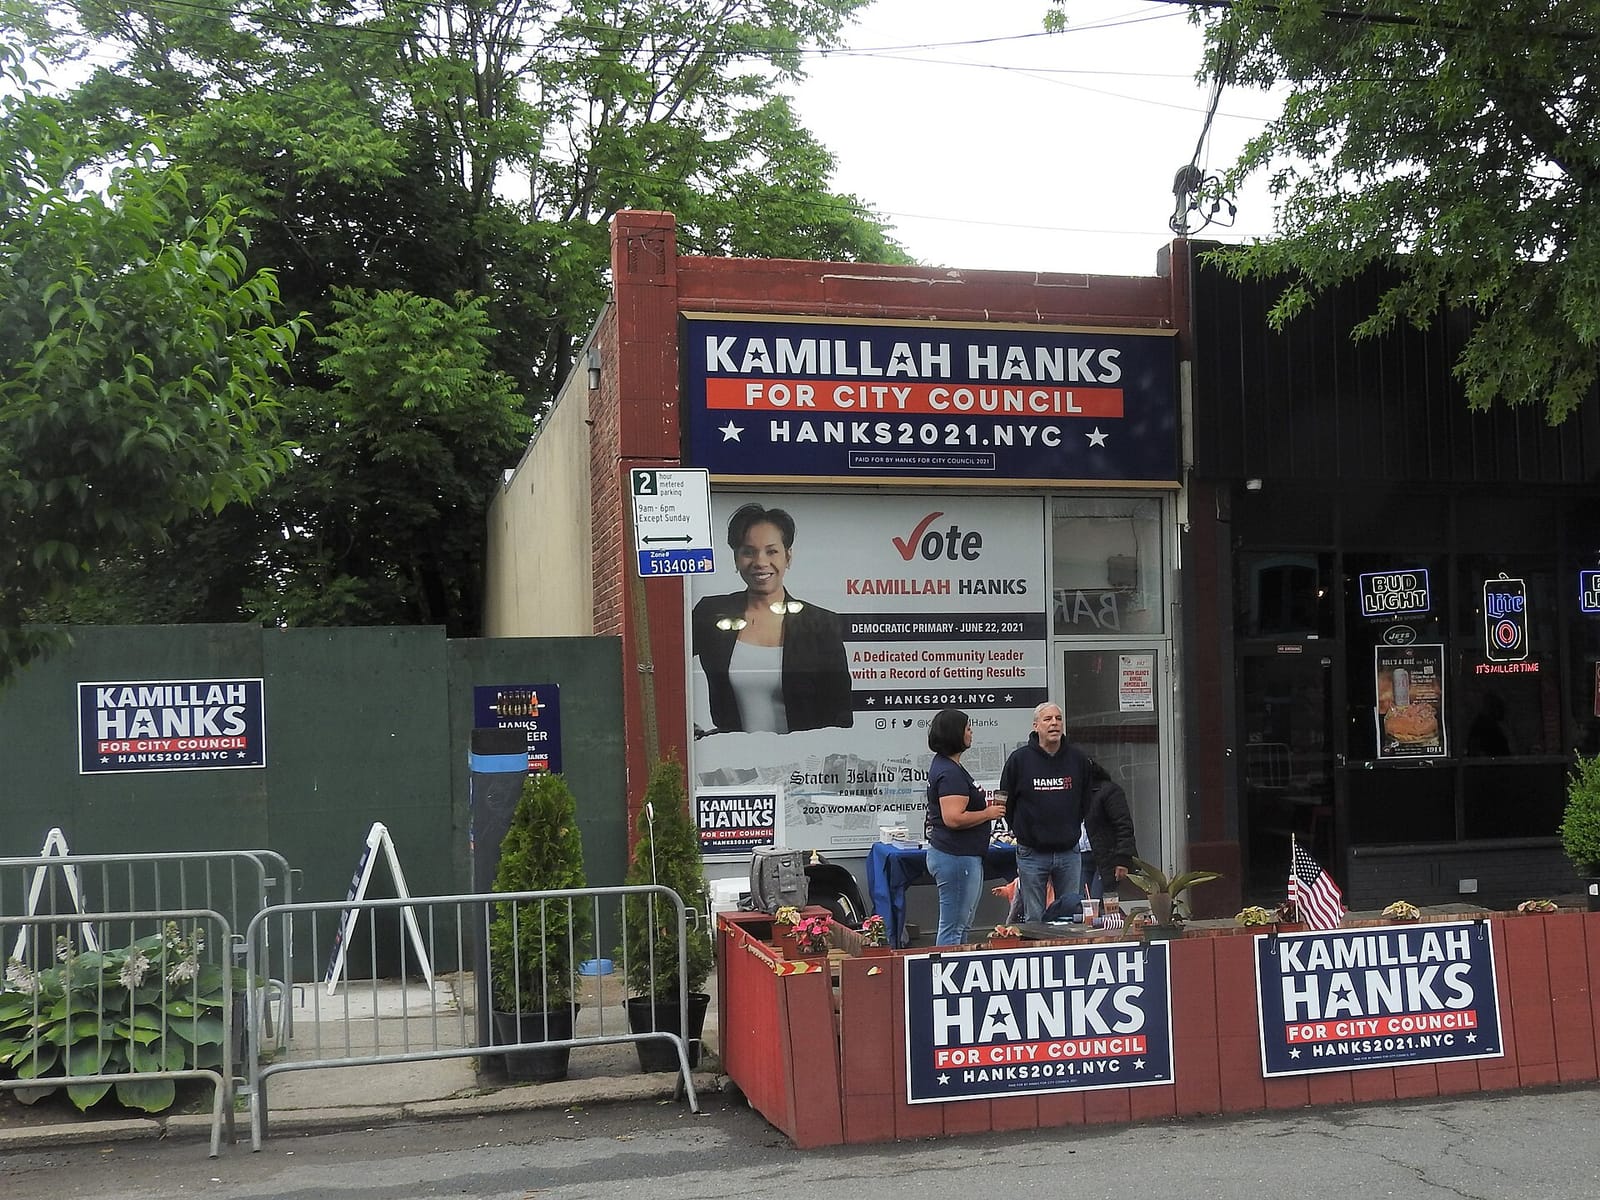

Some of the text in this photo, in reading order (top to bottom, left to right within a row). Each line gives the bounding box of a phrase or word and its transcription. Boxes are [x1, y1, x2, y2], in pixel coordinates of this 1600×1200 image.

[706, 335, 1122, 383] KAMILLAH HANKS
[745, 383, 1083, 414] FOR CITY COUNCIL
[770, 420, 1062, 447] HANKS2021.NYC
[639, 472, 652, 494] 2
[639, 513, 690, 523] Except Sunday
[651, 559, 696, 573] 513408
[846, 579, 1027, 595] KAMILLAH HANKS
[1372, 574, 1417, 593] BUD
[1365, 590, 1426, 611] LIGHT
[1488, 593, 1524, 618] Lite
[851, 623, 911, 634] DEMOCRATIC
[912, 623, 954, 633] PRIMARY
[959, 623, 983, 633] JUNE
[985, 622, 1000, 634] 22,
[1001, 622, 1024, 632] 2021
[853, 650, 1025, 664] A Dedicated Community Leader
[852, 668, 877, 680] with
[889, 667, 927, 679] Record
[929, 667, 941, 678] of
[943, 667, 983, 680] Getting
[986, 666, 1026, 678] Results
[1476, 662, 1539, 674] IT'S MILLER TIME
[96, 684, 246, 708] KAMILLAH
[884, 694, 995, 705] HANKS2021.NYC
[98, 706, 246, 739] HANKS
[101, 738, 245, 752] FOR CITY COUNCIL
[119, 751, 229, 763] HANKS2021.NYC
[790, 770, 839, 785] Staten
[847, 768, 895, 784] Island
[1033, 778, 1064, 786] HANKS
[700, 798, 773, 812] KAMILLAH
[803, 806, 826, 815] 2020
[828, 805, 867, 814] WOMAN
[700, 810, 773, 828] HANKS
[739, 829, 773, 837] COUNCIL
[1279, 929, 1471, 973] KAMILLAH
[932, 951, 1145, 995] KAMILLAH
[1281, 962, 1474, 1022] HANKS
[933, 985, 1145, 1046] HANKS
[1288, 1012, 1474, 1041] FOR CITY COUNCIL
[938, 1037, 1144, 1066] FOR CITY COUNCIL
[1312, 1033, 1455, 1058] HANKS2021.NYC
[963, 1058, 1121, 1083] HANKS2021.NYC
